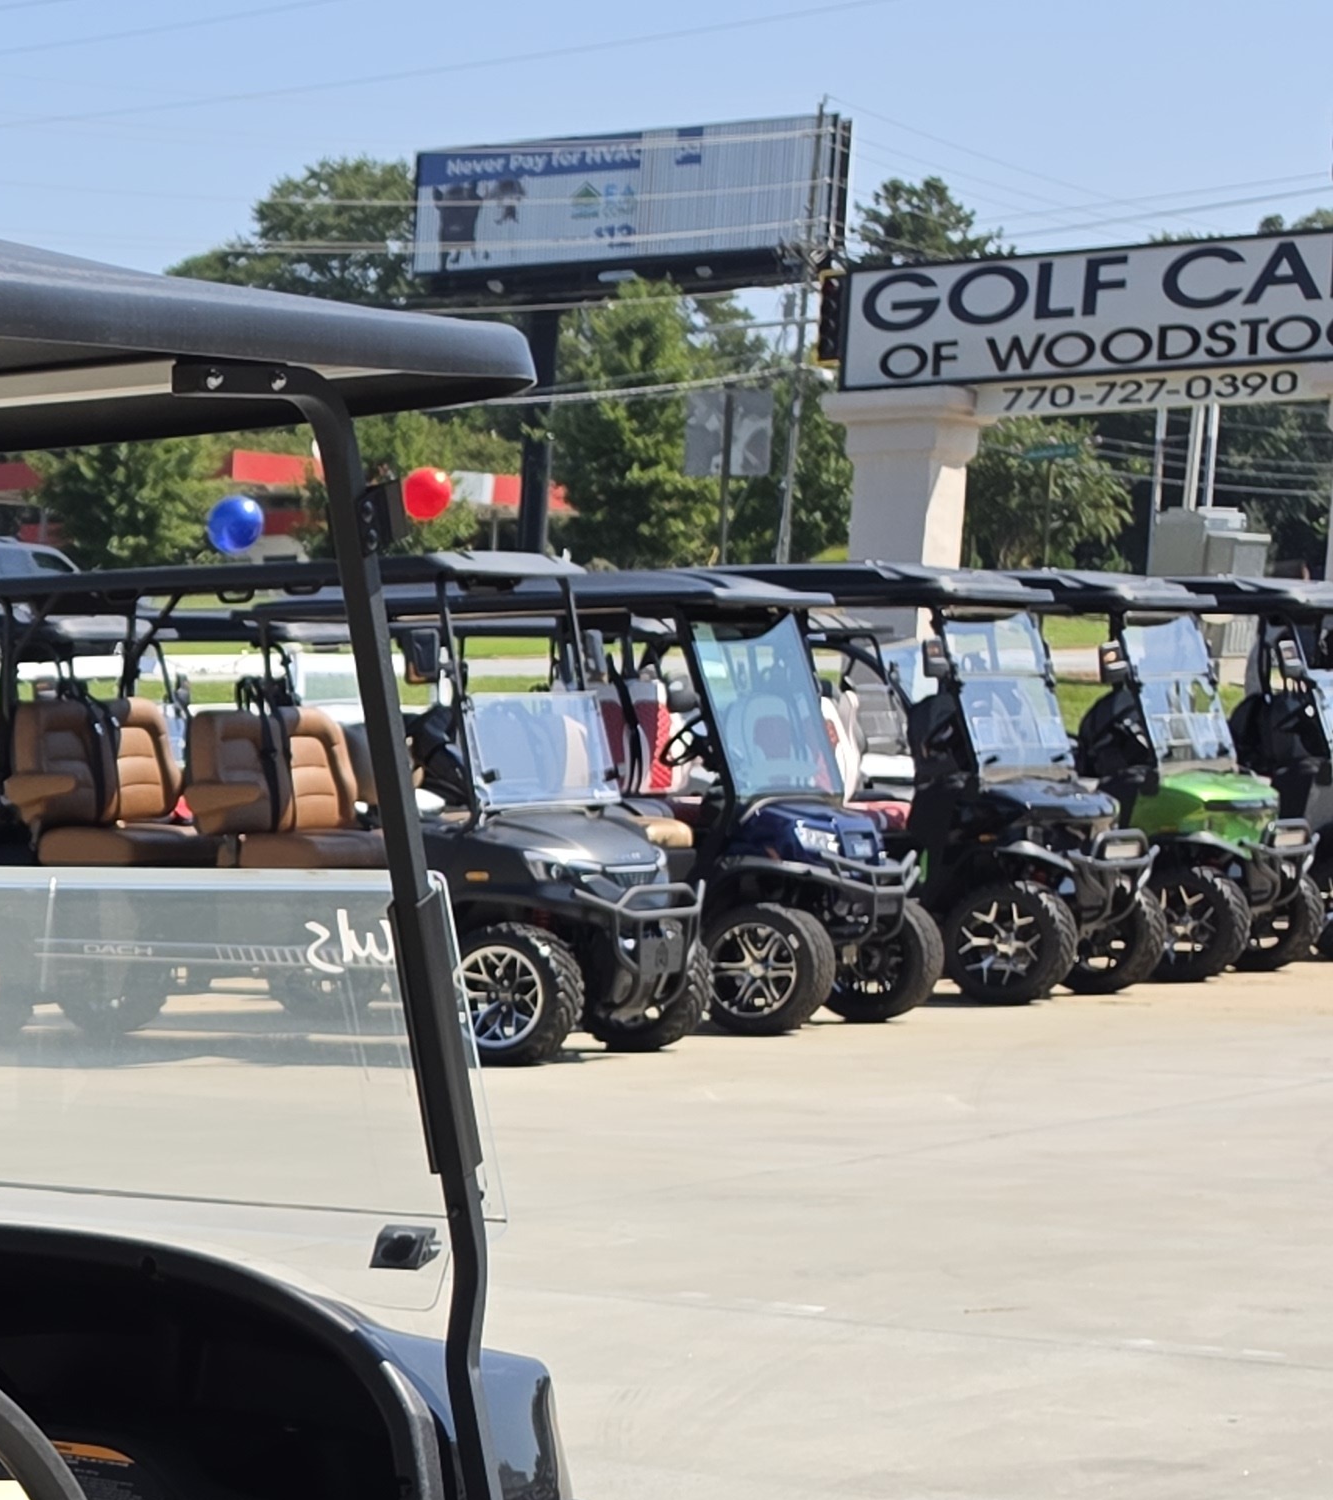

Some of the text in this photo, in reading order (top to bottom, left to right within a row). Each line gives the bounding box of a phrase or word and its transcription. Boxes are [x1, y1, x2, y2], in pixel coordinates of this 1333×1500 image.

[446, 154, 504, 177] Never
[509, 153, 548, 174] Pay
[551, 148, 582, 168] for
[861, 238, 1333, 332] GOLF CA
[879, 314, 1333, 380] OF WOODSTO
[1002, 370, 1298, 411] 770-727-0390
[83, 943, 153, 956] DACH
